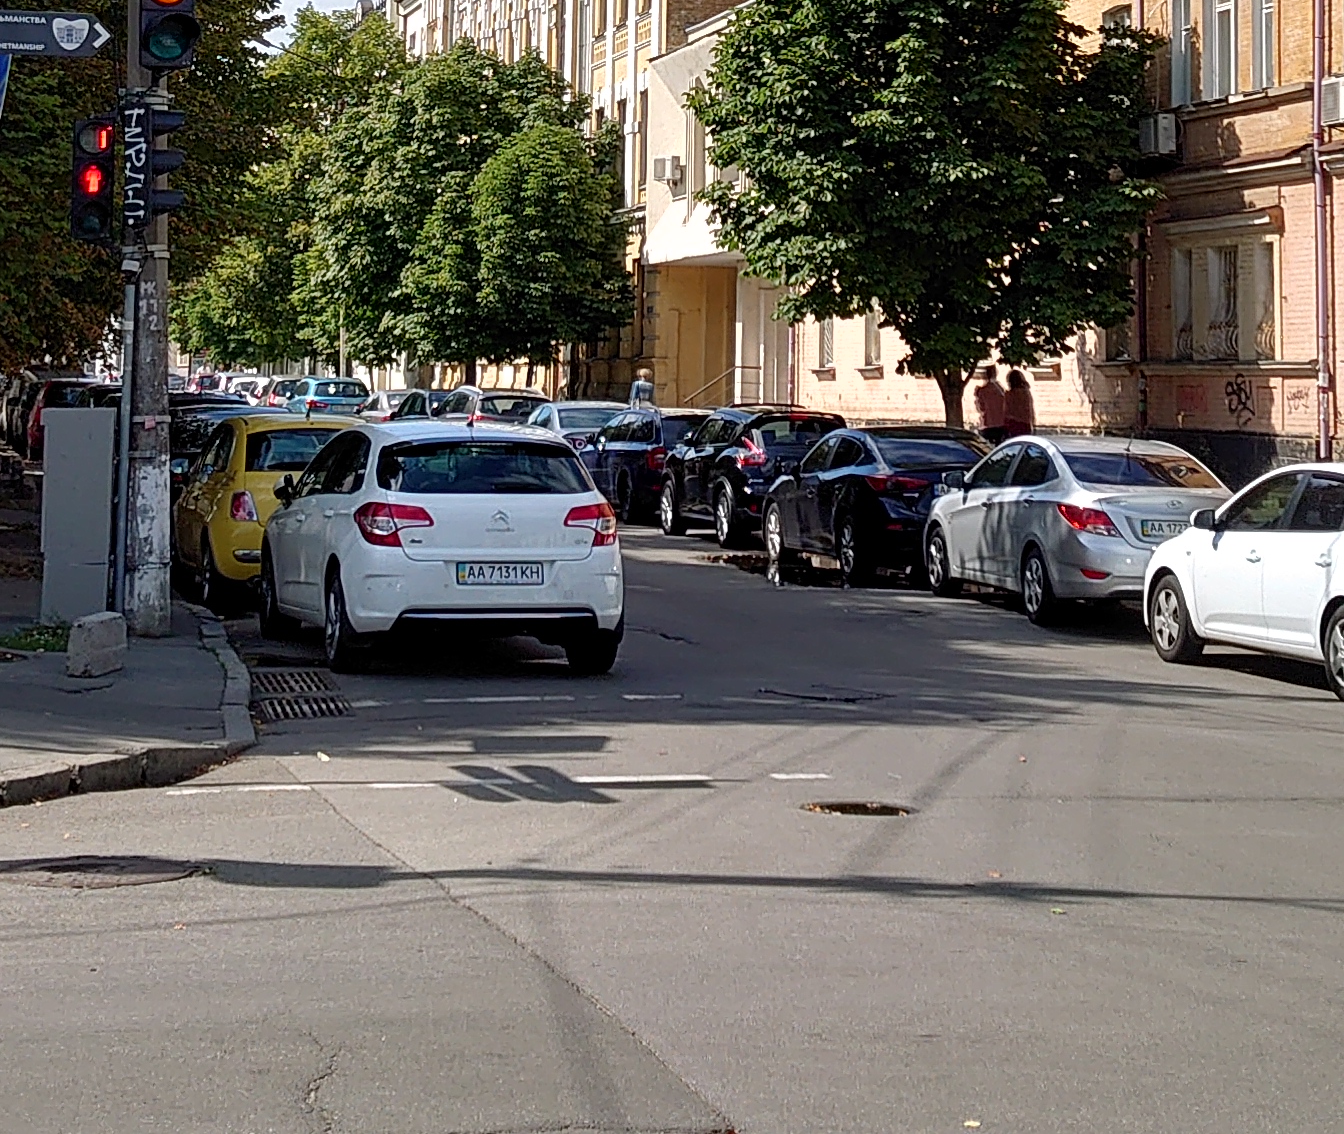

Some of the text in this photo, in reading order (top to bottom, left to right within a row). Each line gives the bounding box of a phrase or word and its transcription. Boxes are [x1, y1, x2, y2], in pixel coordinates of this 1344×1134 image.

[1150, 522, 1165, 533] AA
[467, 565, 540, 579] AA 7131 KH
